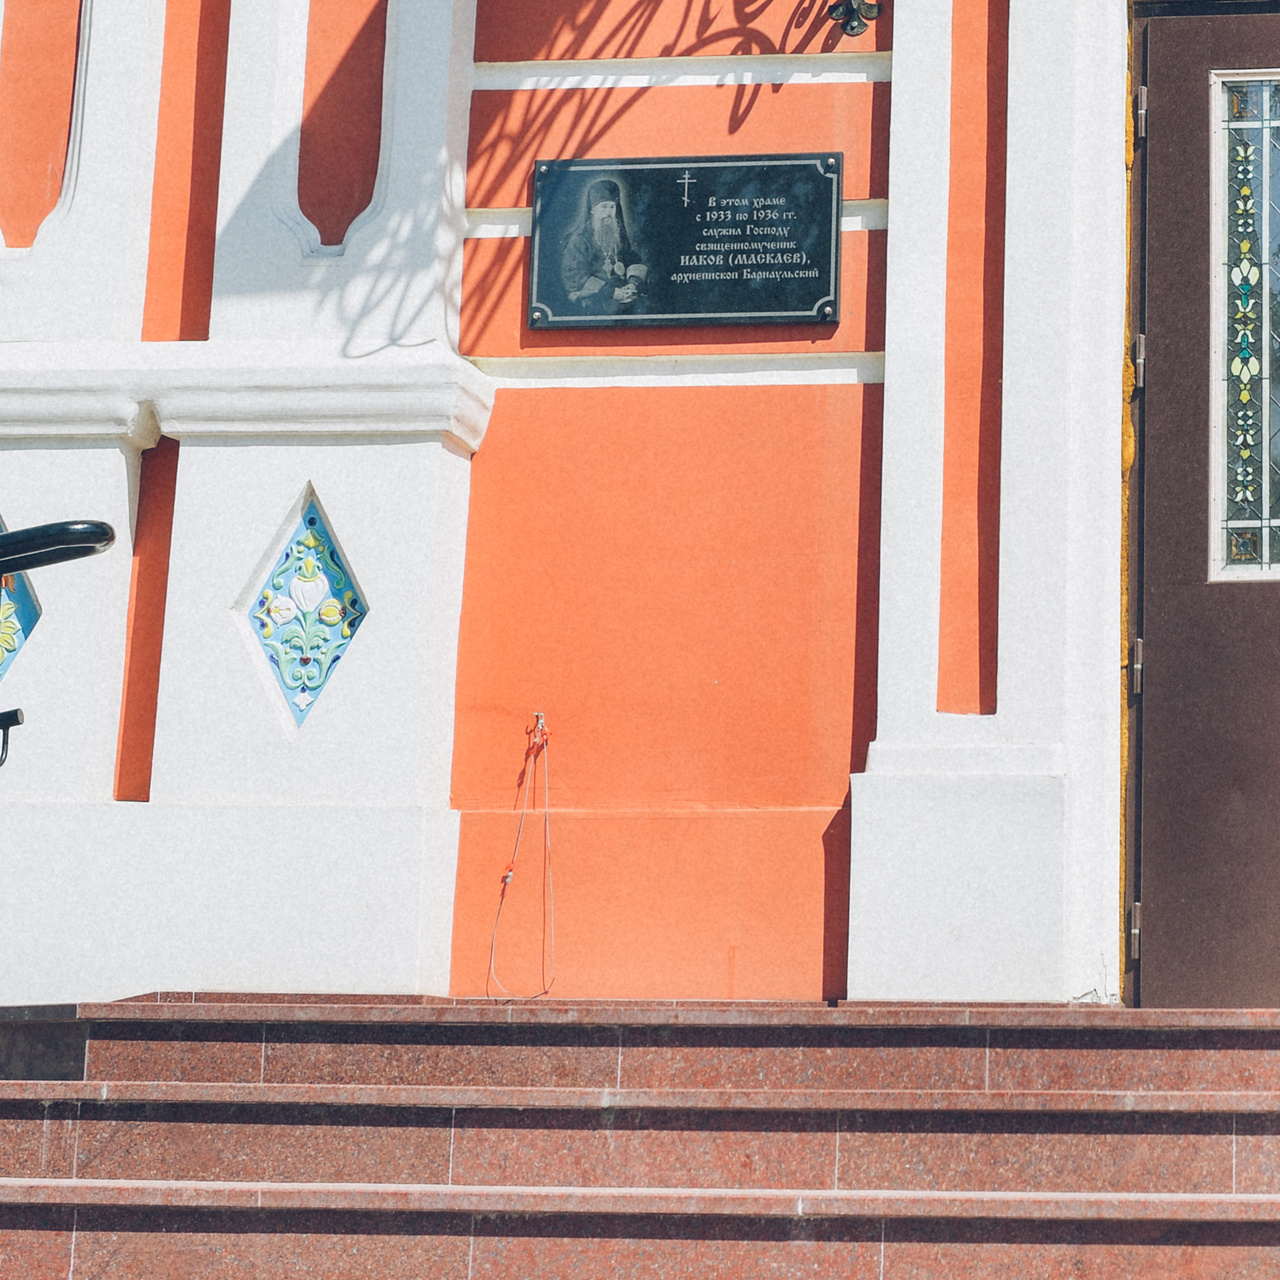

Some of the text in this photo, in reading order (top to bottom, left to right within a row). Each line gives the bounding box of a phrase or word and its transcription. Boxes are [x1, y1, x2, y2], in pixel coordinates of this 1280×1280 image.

[708, 197, 786, 208] В этом храме
[706, 211, 731, 221] 1933
[736, 213, 748, 221] по
[753, 210, 778, 220] 1936
[703, 225, 790, 238] служил Господу
[695, 241, 796, 252] священномученик
[680, 253, 811, 266] ИАКОВ (МАСКАЕВ),
[671, 268, 819, 283] архиепископ Барнаульский
